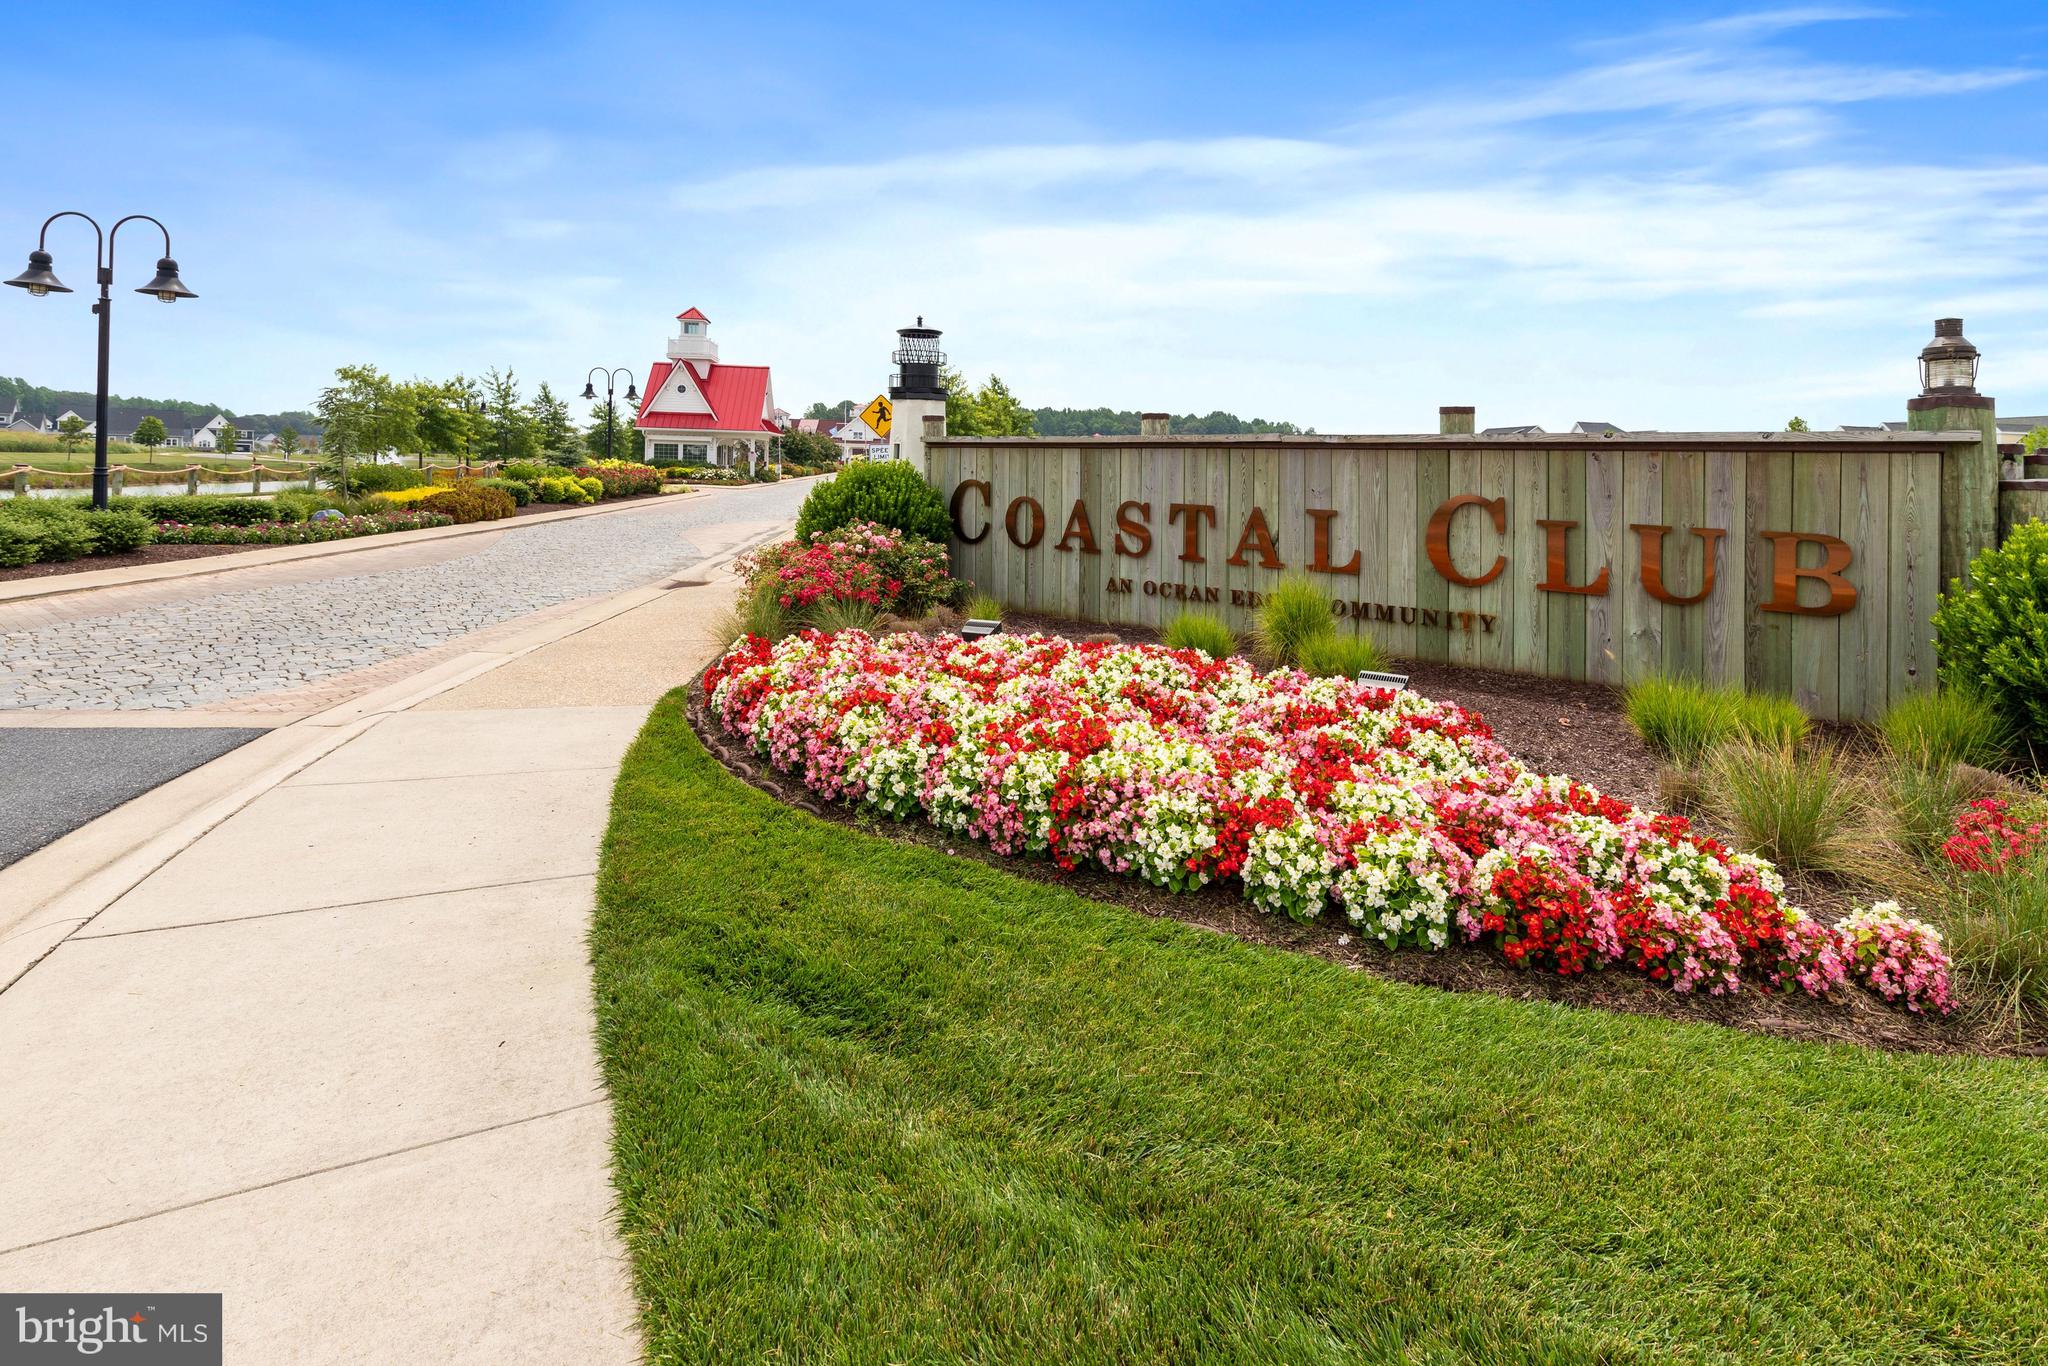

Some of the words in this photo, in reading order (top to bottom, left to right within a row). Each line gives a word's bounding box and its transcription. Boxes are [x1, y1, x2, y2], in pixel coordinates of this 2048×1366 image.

[950, 479, 1361, 575] COASTAL
[1426, 494, 1857, 617] CLUB
[1106, 577, 1132, 593] AN
[1143, 581, 1219, 602] OCEAN
[1331, 599, 1498, 634] OMMUNITY
